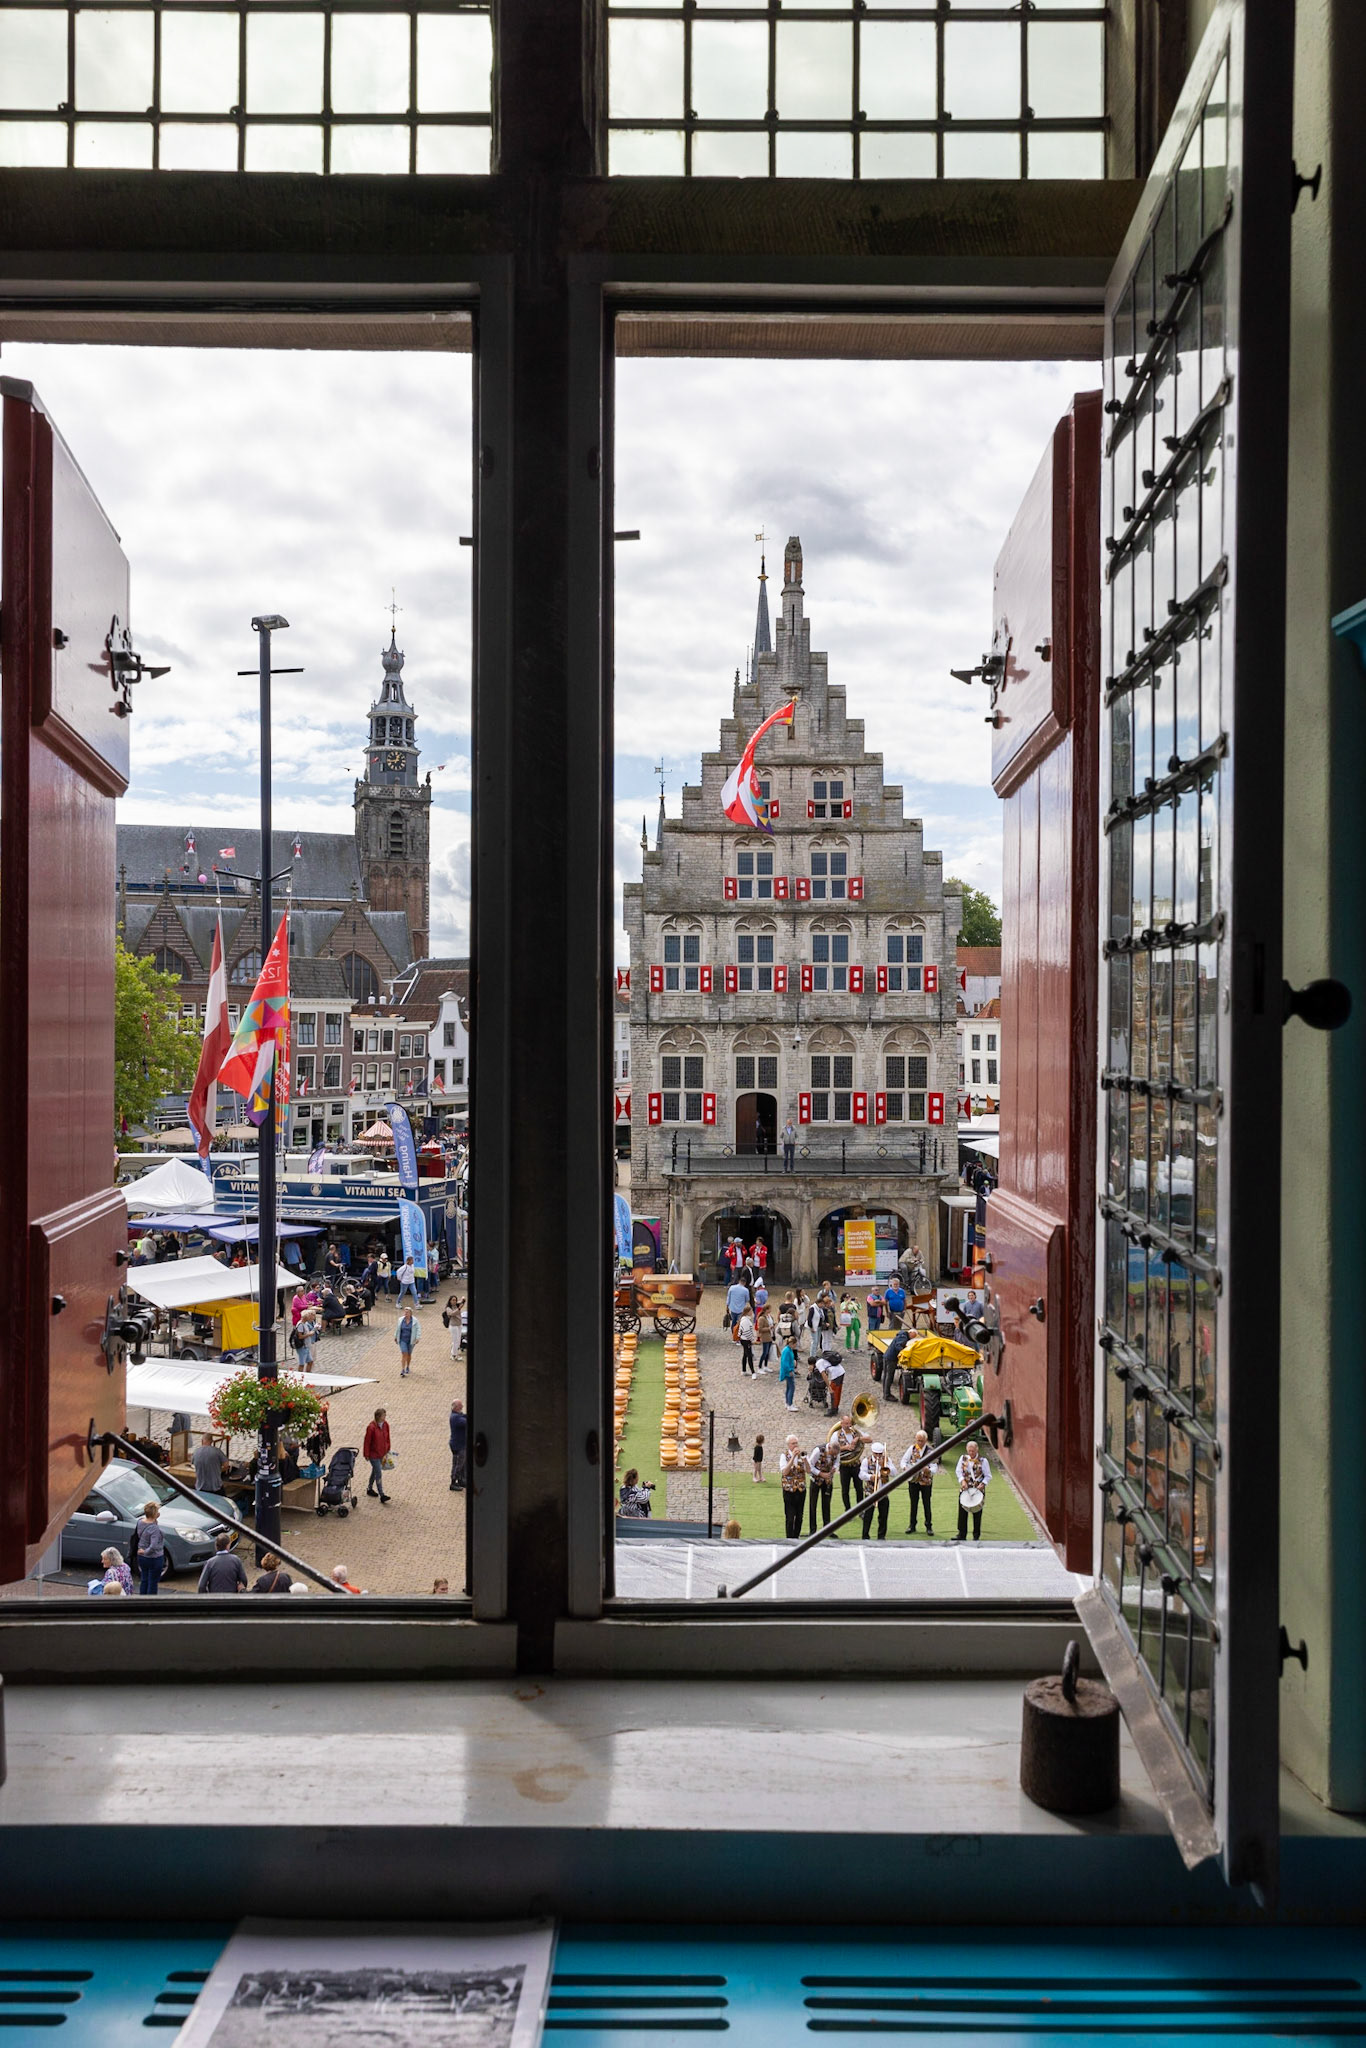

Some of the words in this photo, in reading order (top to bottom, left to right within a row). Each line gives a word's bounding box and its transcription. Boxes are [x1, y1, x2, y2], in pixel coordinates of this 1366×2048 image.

[231, 1182, 259, 1192] VITAM
[344, 1186, 386, 1196] VITAMIN
[388, 1188, 406, 1197] SEA
